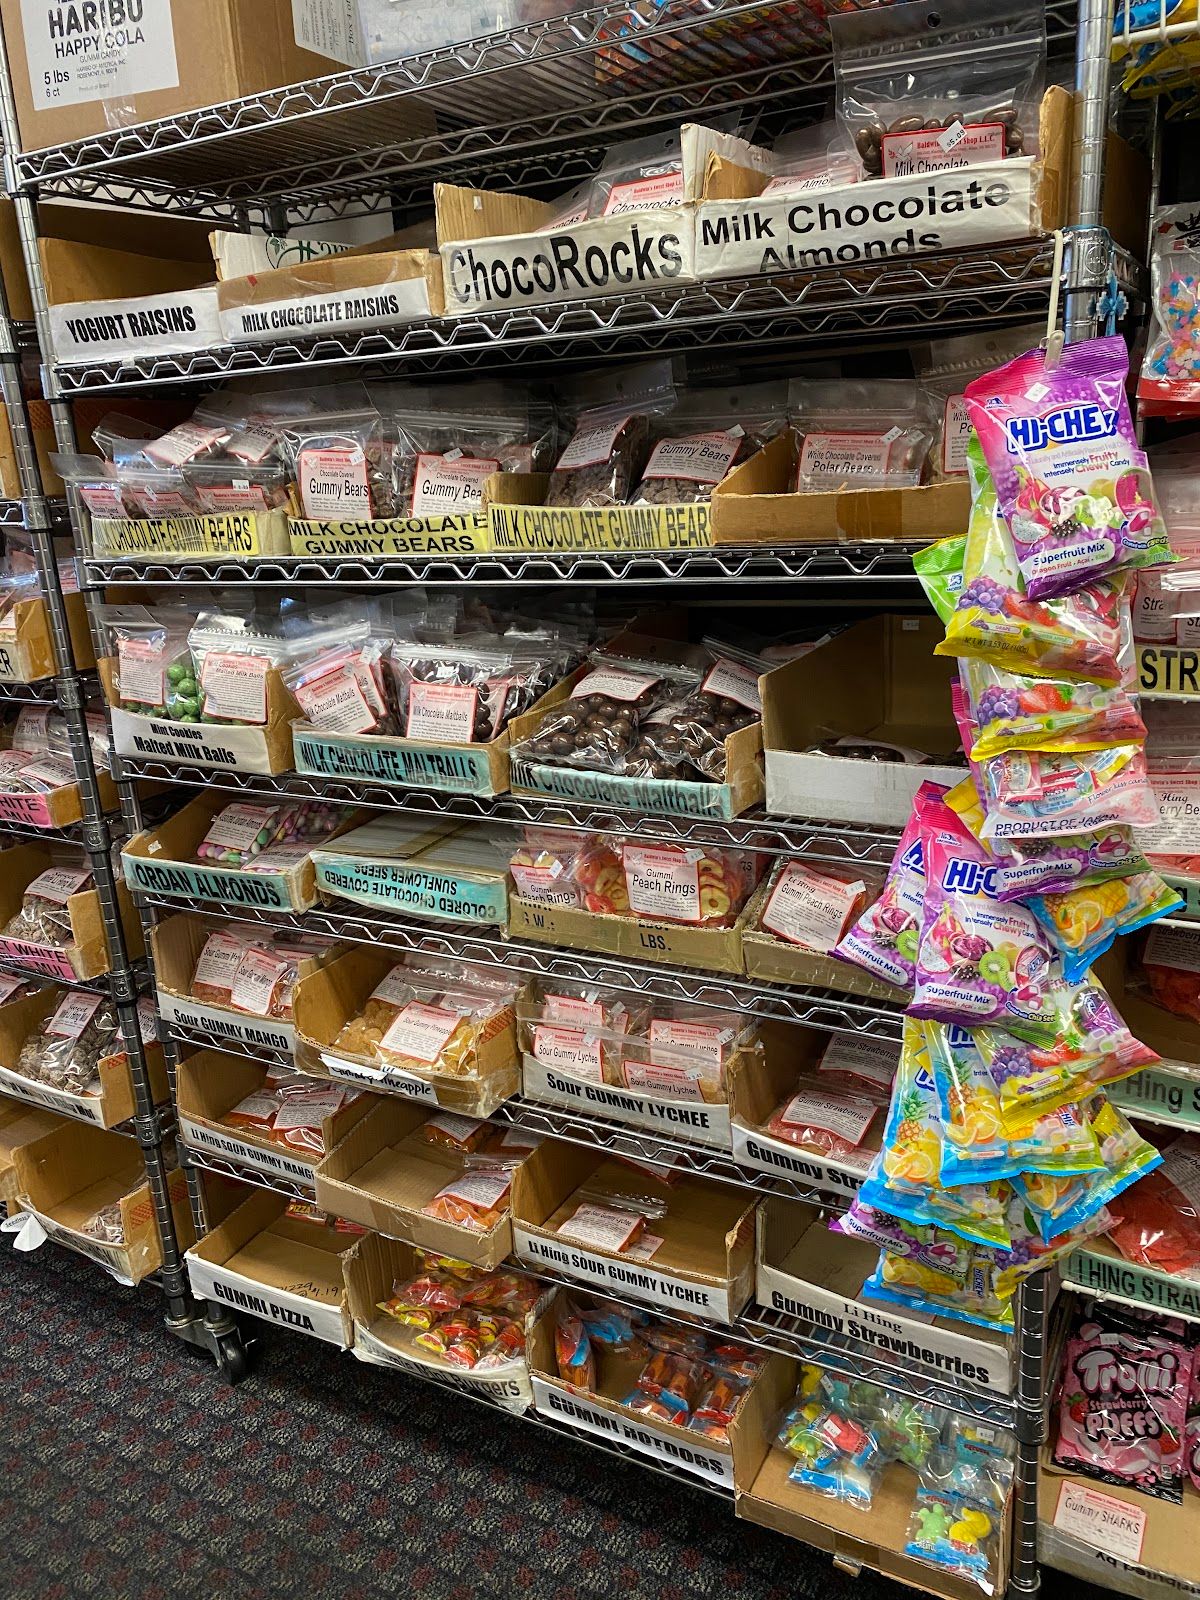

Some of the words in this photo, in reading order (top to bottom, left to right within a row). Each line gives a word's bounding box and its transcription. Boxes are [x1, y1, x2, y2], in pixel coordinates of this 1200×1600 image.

[55, 36, 100, 58] HAPPY
[105, 27, 145, 49] COLA
[44, 71, 51, 85] 5
[53, 69, 70, 83] lbs
[45, 88, 51, 98] 6
[52, 87, 61, 97] ct
[895, 160, 914, 177] Milk
[917, 158, 969, 175] Chocolate
[612, 197, 681, 214] Chocorocks
[702, 213, 775, 246] Milk
[788, 180, 1011, 234] Chocolate
[760, 229, 943, 273] Almonds
[451, 224, 683, 303] ChocoRocks
[65, 313, 127, 344] YOGURT
[129, 305, 197, 338] RAISINS
[241, 312, 271, 333] MILK
[271, 302, 342, 329] CHOCOLATE
[344, 294, 400, 320] RAISINS
[659, 444, 699, 456] Gummy
[699, 447, 731, 462] Bears
[807, 449, 824, 461] White
[825, 450, 855, 462] Chocolate
[856, 450, 881, 461] Covered
[1053, 457, 1090, 470] Immensely
[1089, 450, 1119, 463] Fruity
[319, 469, 339, 479] Chocolate
[339, 470, 355, 479] Covered
[436, 472, 459, 482] Chocolate
[459, 475, 479, 484] Covered
[812, 460, 839, 473] Polar
[1044, 467, 1075, 478] Intensely
[1075, 461, 1110, 474] Chewy
[1110, 459, 1130, 468] Candy
[309, 478, 342, 500] Gummy
[344, 480, 369, 497] Bears
[422, 479, 461, 501] Gummy
[463, 484, 482, 501] Bea
[207, 515, 252, 552] BEARS
[289, 520, 338, 536] MILK
[339, 513, 488, 536] CHOCOLATE
[491, 508, 525, 547] MILK
[523, 509, 608, 548] CHOCOLATE
[607, 506, 662, 548] GUMMY
[305, 537, 385, 554] GUMMY
[393, 535, 475, 553] BEARS
[1033, 546, 1086, 566] Superfruit
[1086, 543, 1105, 555] Mix
[1141, 649, 1200, 690] STR
[334, 687, 355, 705] Maltballs
[421, 708, 445, 720] Chocolate
[444, 708, 468, 722] Maltballs
[151, 723, 169, 736] Mint
[169, 725, 203, 740] Cookies
[133, 735, 178, 756] Malted
[175, 742, 203, 761] Milk
[201, 747, 237, 766] Balls
[300, 742, 328, 773] MILK
[327, 745, 400, 782] CHOCOLATE
[400, 750, 479, 787] MALTBALLS
[0, 796, 40, 811] HITE
[540, 767, 631, 807] Chocolate
[633, 782, 725, 819] Maltballs
[1160, 792, 1188, 803] Hing
[996, 820, 1056, 832] PRODUCT
[1060, 818, 1077, 827] OF
[325, 869, 369, 893] COVERED
[354, 864, 388, 881] SEEDS
[391, 866, 458, 895] SUNFLOWER
[646, 867, 674, 880] Gummi
[943, 857, 1000, 897] HI-C
[1003, 866, 1052, 880] Superfruit
[1054, 862, 1074, 871] Mix
[194, 871, 282, 907] ALMONDS
[372, 882, 435, 909] CHOCOLATE
[530, 884, 552, 895] Gummi
[632, 874, 662, 891] Peach
[664, 881, 696, 897] Rings
[439, 897, 496, 919] COLORED
[546, 891, 576, 906] Rings
[781, 883, 804, 901] Gummi
[802, 892, 823, 910] Peach
[821, 901, 843, 920] Rings
[965, 916, 993, 932] Intensely
[993, 921, 1023, 938] Chewy
[976, 911, 1009, 925] Immensely
[1008, 916, 1030, 932] Fruity
[13, 942, 68, 964] WHITE
[640, 933, 672, 951] LBS.
[846, 937, 885, 967] Superfruit
[883, 961, 902, 977] Mix
[926, 985, 973, 1002] Superfruit
[973, 994, 991, 1005] Mix
[173, 1008, 199, 1027] Sour
[200, 1016, 244, 1039] GUMMY
[244, 1027, 289, 1050] MANGO
[403, 1016, 414, 1026] Sour
[414, 1019, 430, 1032] Gummy
[538, 1044, 553, 1056] Sour
[553, 1048, 578, 1062] Gummy
[577, 1050, 598, 1064] Lychee
[833, 1037, 857, 1049] Gummi
[857, 1041, 899, 1062] Strawberries
[381, 1076, 432, 1096] ineapple
[630, 1077, 647, 1088] Sour
[646, 1081, 672, 1096] Gummy
[672, 1082, 698, 1096] Lychee
[1126, 1072, 1183, 1114] Hing
[546, 1072, 583, 1097] Sour
[584, 1085, 644, 1114] GUMMY
[647, 1103, 711, 1129] LYCHEE
[798, 1096, 824, 1109] Gummi
[823, 1101, 868, 1123] Strawberries
[190, 1128, 200, 1140] Li
[199, 1133, 221, 1149] Hing
[221, 1139, 246, 1157] SOUR
[247, 1147, 282, 1170] GUMMY
[746, 1140, 823, 1180] Gummy
[288, 1204, 311, 1215] PIZZA
[848, 1218, 887, 1243] Superfruit
[886, 1238, 904, 1250] Mix
[528, 1240, 540, 1254] Li
[540, 1242, 570, 1266] Hing
[572, 1253, 606, 1277] SOUR
[608, 1264, 658, 1292] GUMMY
[659, 1281, 710, 1308] LYCHEE
[1089, 1258, 1136, 1297] HING
[213, 1281, 269, 1316] GUMMI
[269, 1302, 315, 1333] PIZZA
[842, 1302, 859, 1315] Li
[862, 1310, 903, 1334] Hing
[771, 1290, 844, 1333] Gummy
[846, 1319, 990, 1384] Strawberries
[1077, 1350, 1175, 1392] Trolli
[1089, 1399, 1149, 1411] Strawberry
[548, 1392, 620, 1434] GUMMI
[622, 1421, 725, 1476] HOTDOGS
[1086, 1411, 1160, 1440] PUFFS
[1065, 1497, 1100, 1519] Gummy
[1101, 1510, 1141, 1535] SHARKS
